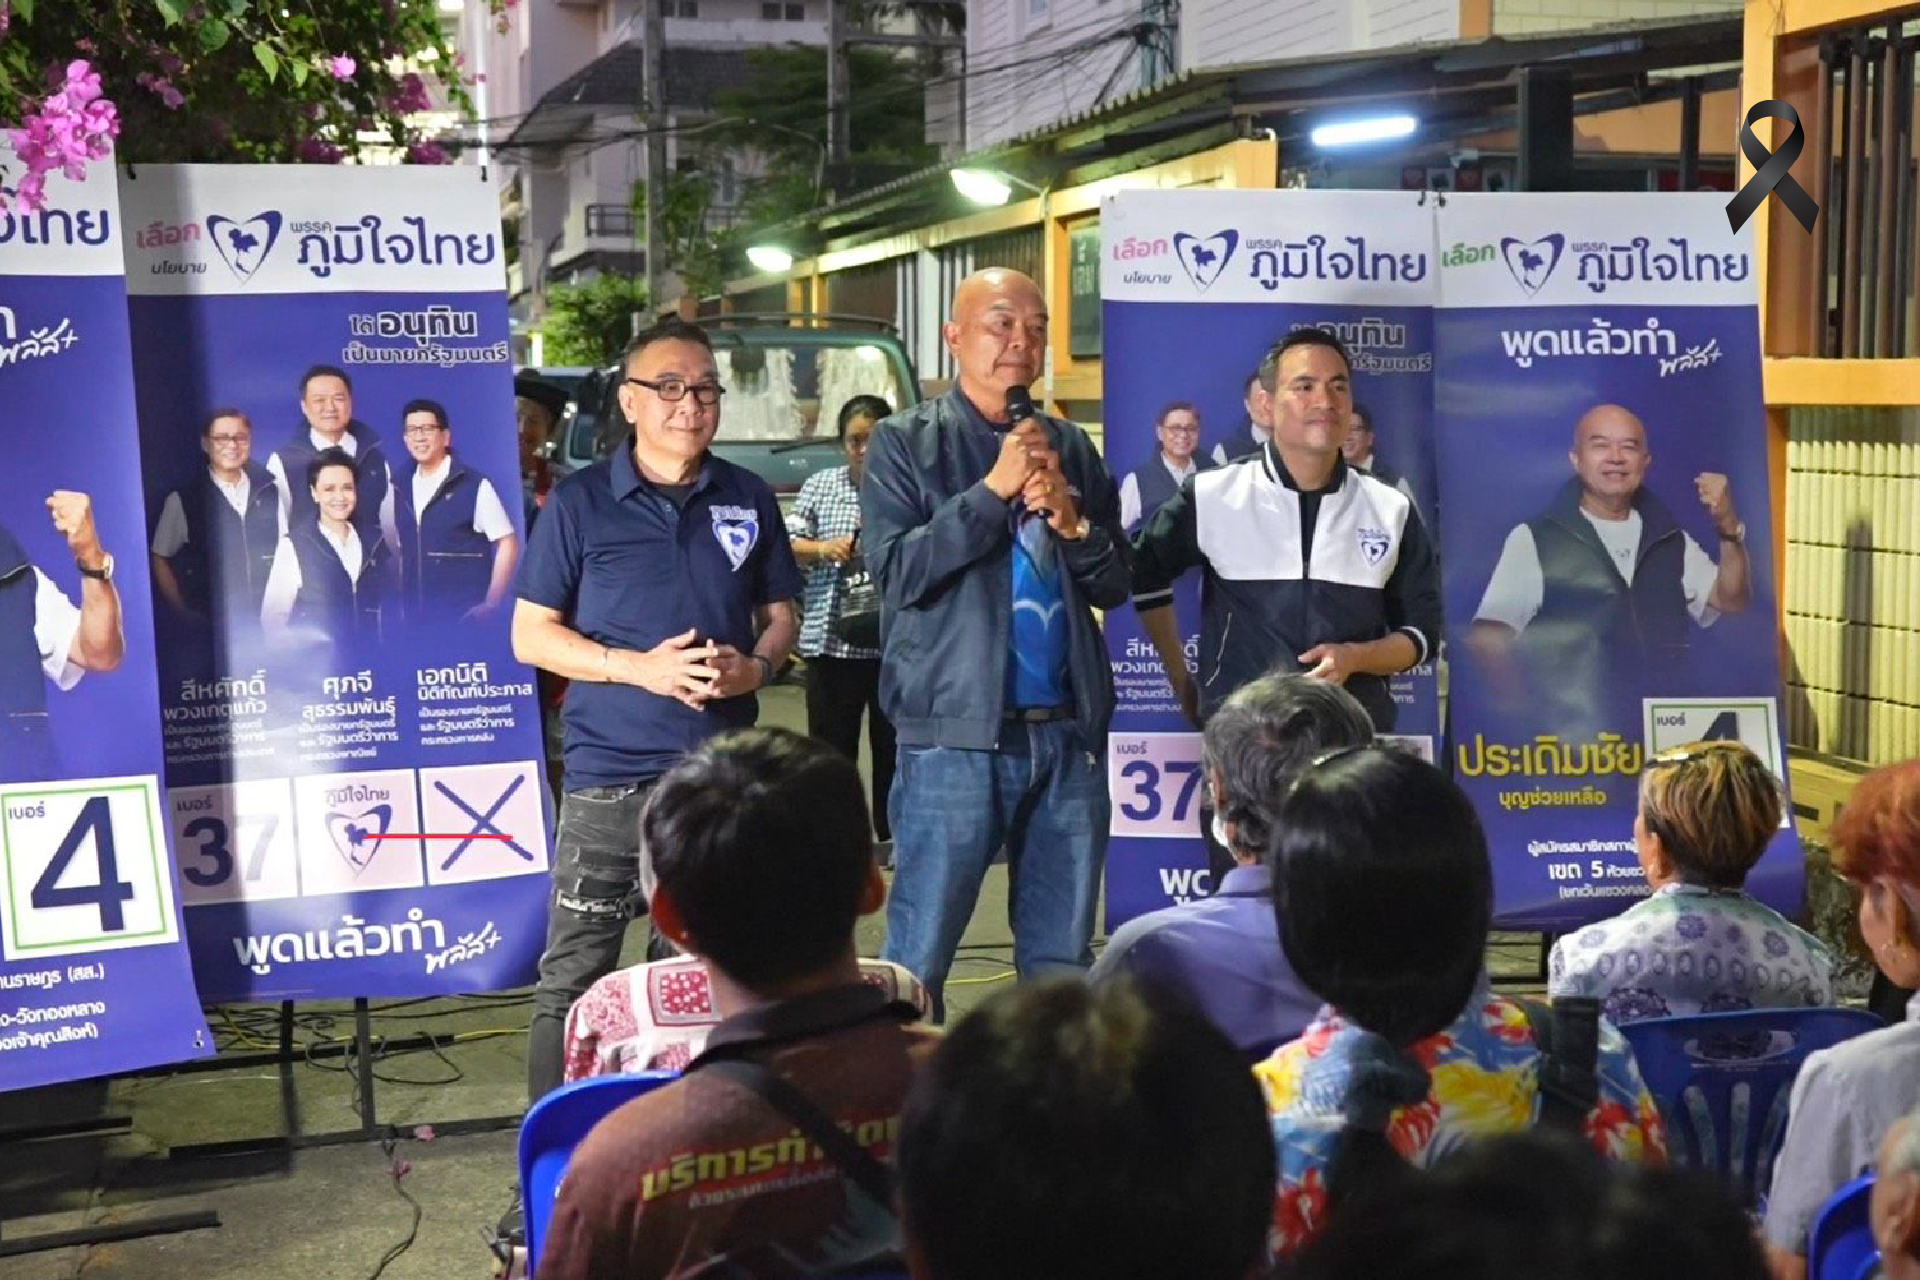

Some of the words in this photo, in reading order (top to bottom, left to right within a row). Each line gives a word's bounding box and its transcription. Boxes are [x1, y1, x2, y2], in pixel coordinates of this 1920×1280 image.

[136, 219, 200, 250] เลือก
[290, 219, 333, 234] พรรค
[297, 213, 496, 278] ภูมิใจไทย
[1113, 235, 1169, 262] เลือก
[1245, 237, 1283, 250] พรรค
[1441, 243, 1496, 268] เลือก
[1570, 241, 1608, 253] พรรค
[151, 259, 207, 275] นโยบาย
[1250, 234, 1427, 291] ภูมิใจไทย
[1577, 236, 1749, 293] ภูมิใจไทย
[1122, 270, 1172, 285] นโยบาย
[377, 306, 478, 346] อนุทิน
[342, 340, 509, 368] เป็นนายกรัฐมนตรี
[1501, 317, 1677, 369] พูดแล้วทำ
[323, 669, 373, 701] ศุภจี
[417, 662, 488, 686] เอกนิติ
[1657, 711, 1687, 728] เบอร์
[1116, 741, 1148, 755] เบอร์
[1458, 731, 1643, 779] ประเดิมชัย
[177, 796, 213, 812] เบอร์
[1120, 760, 1201, 822] 37
[9, 800, 45, 820] เบอร์
[31, 795, 134, 932] 4
[1548, 863, 1581, 880] เขต
[1591, 860, 1604, 879] 5
[232, 907, 446, 976] พูดแล้วทำ
[0, 970, 62, 990] นราษฎร
[0, 1021, 99, 1051] งเจ้าคุณสิงห์)
